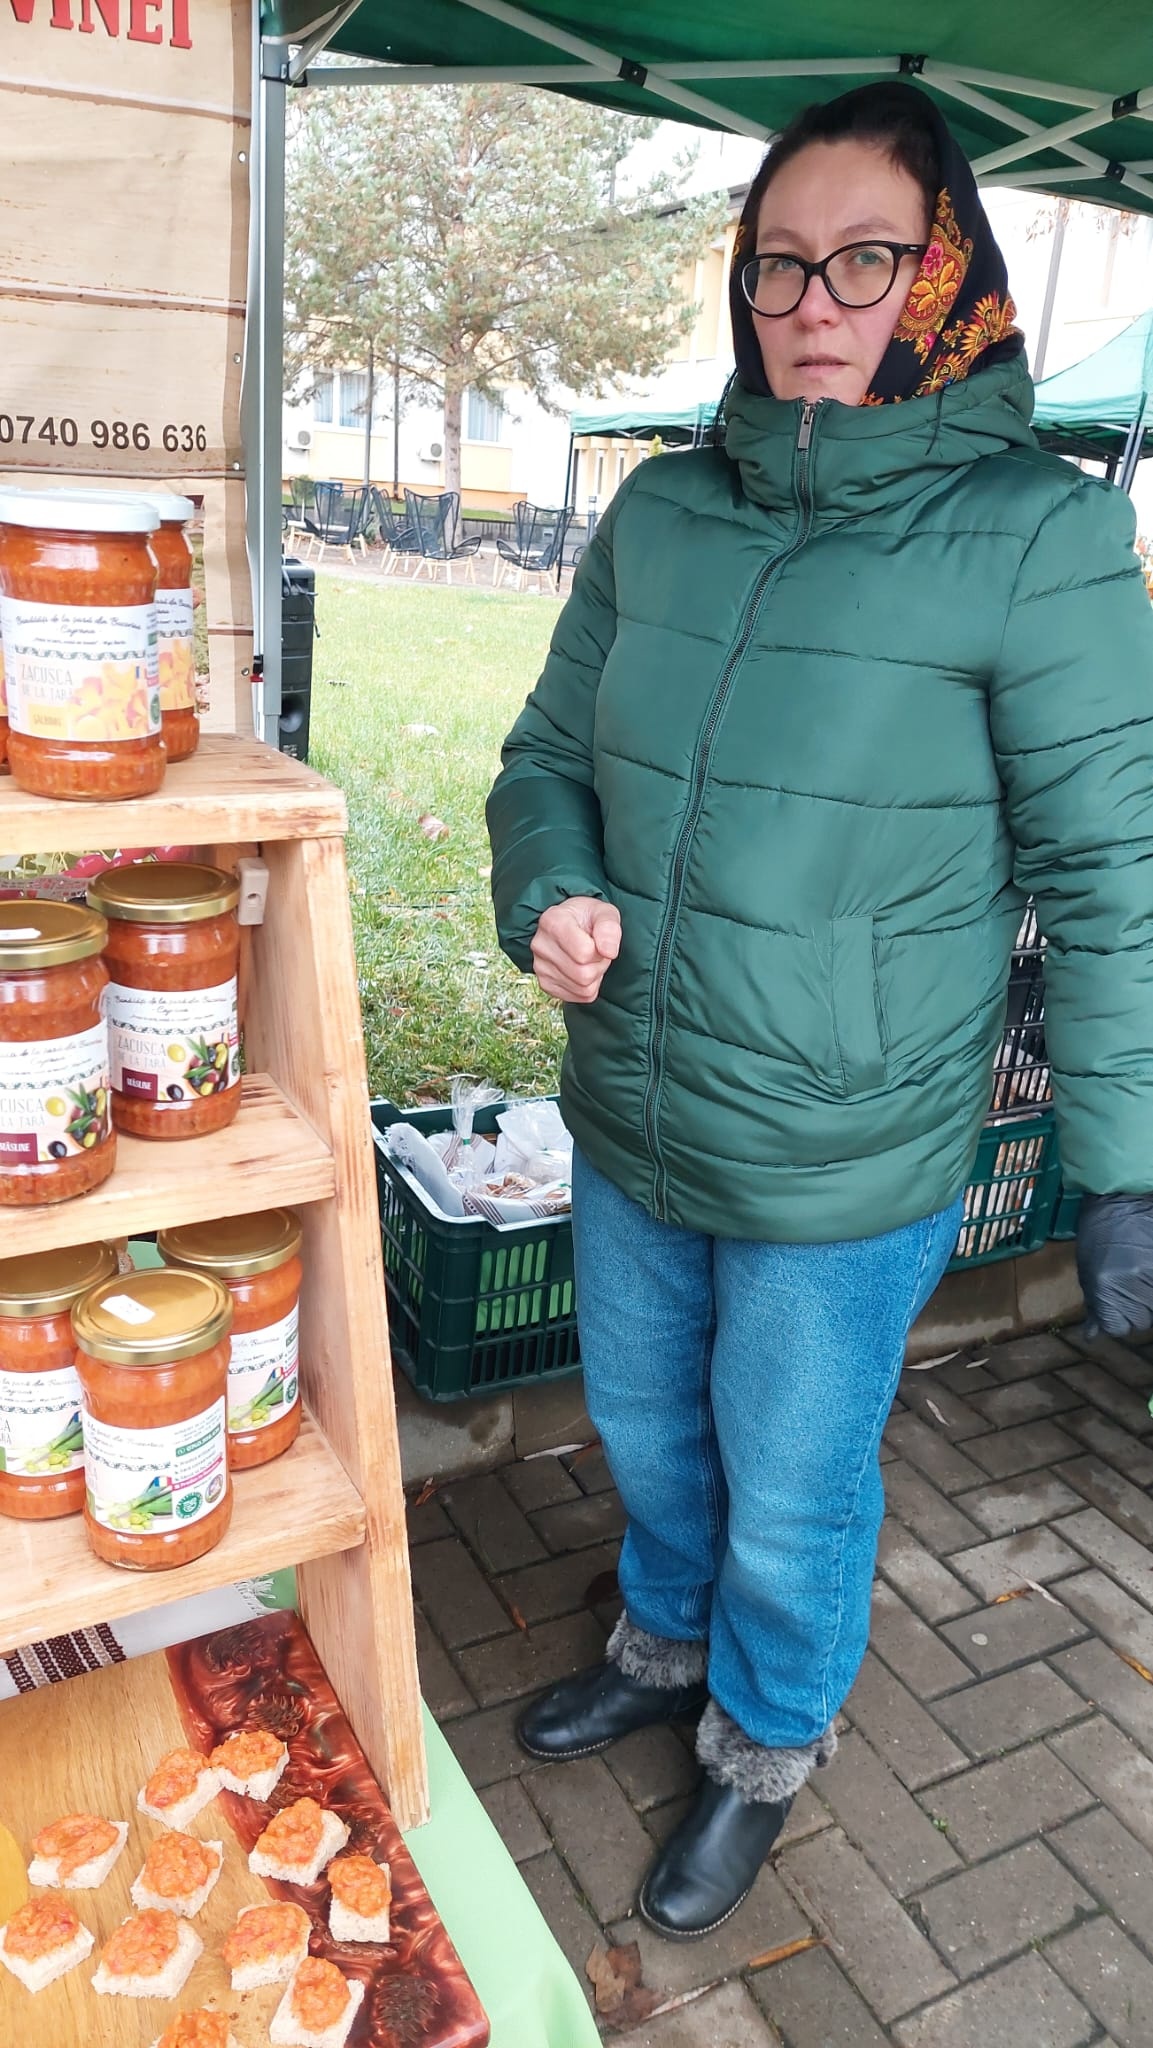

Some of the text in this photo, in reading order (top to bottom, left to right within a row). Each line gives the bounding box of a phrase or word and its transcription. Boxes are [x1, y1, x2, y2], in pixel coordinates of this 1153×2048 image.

[0, 414, 207, 452] 0740 986 636
